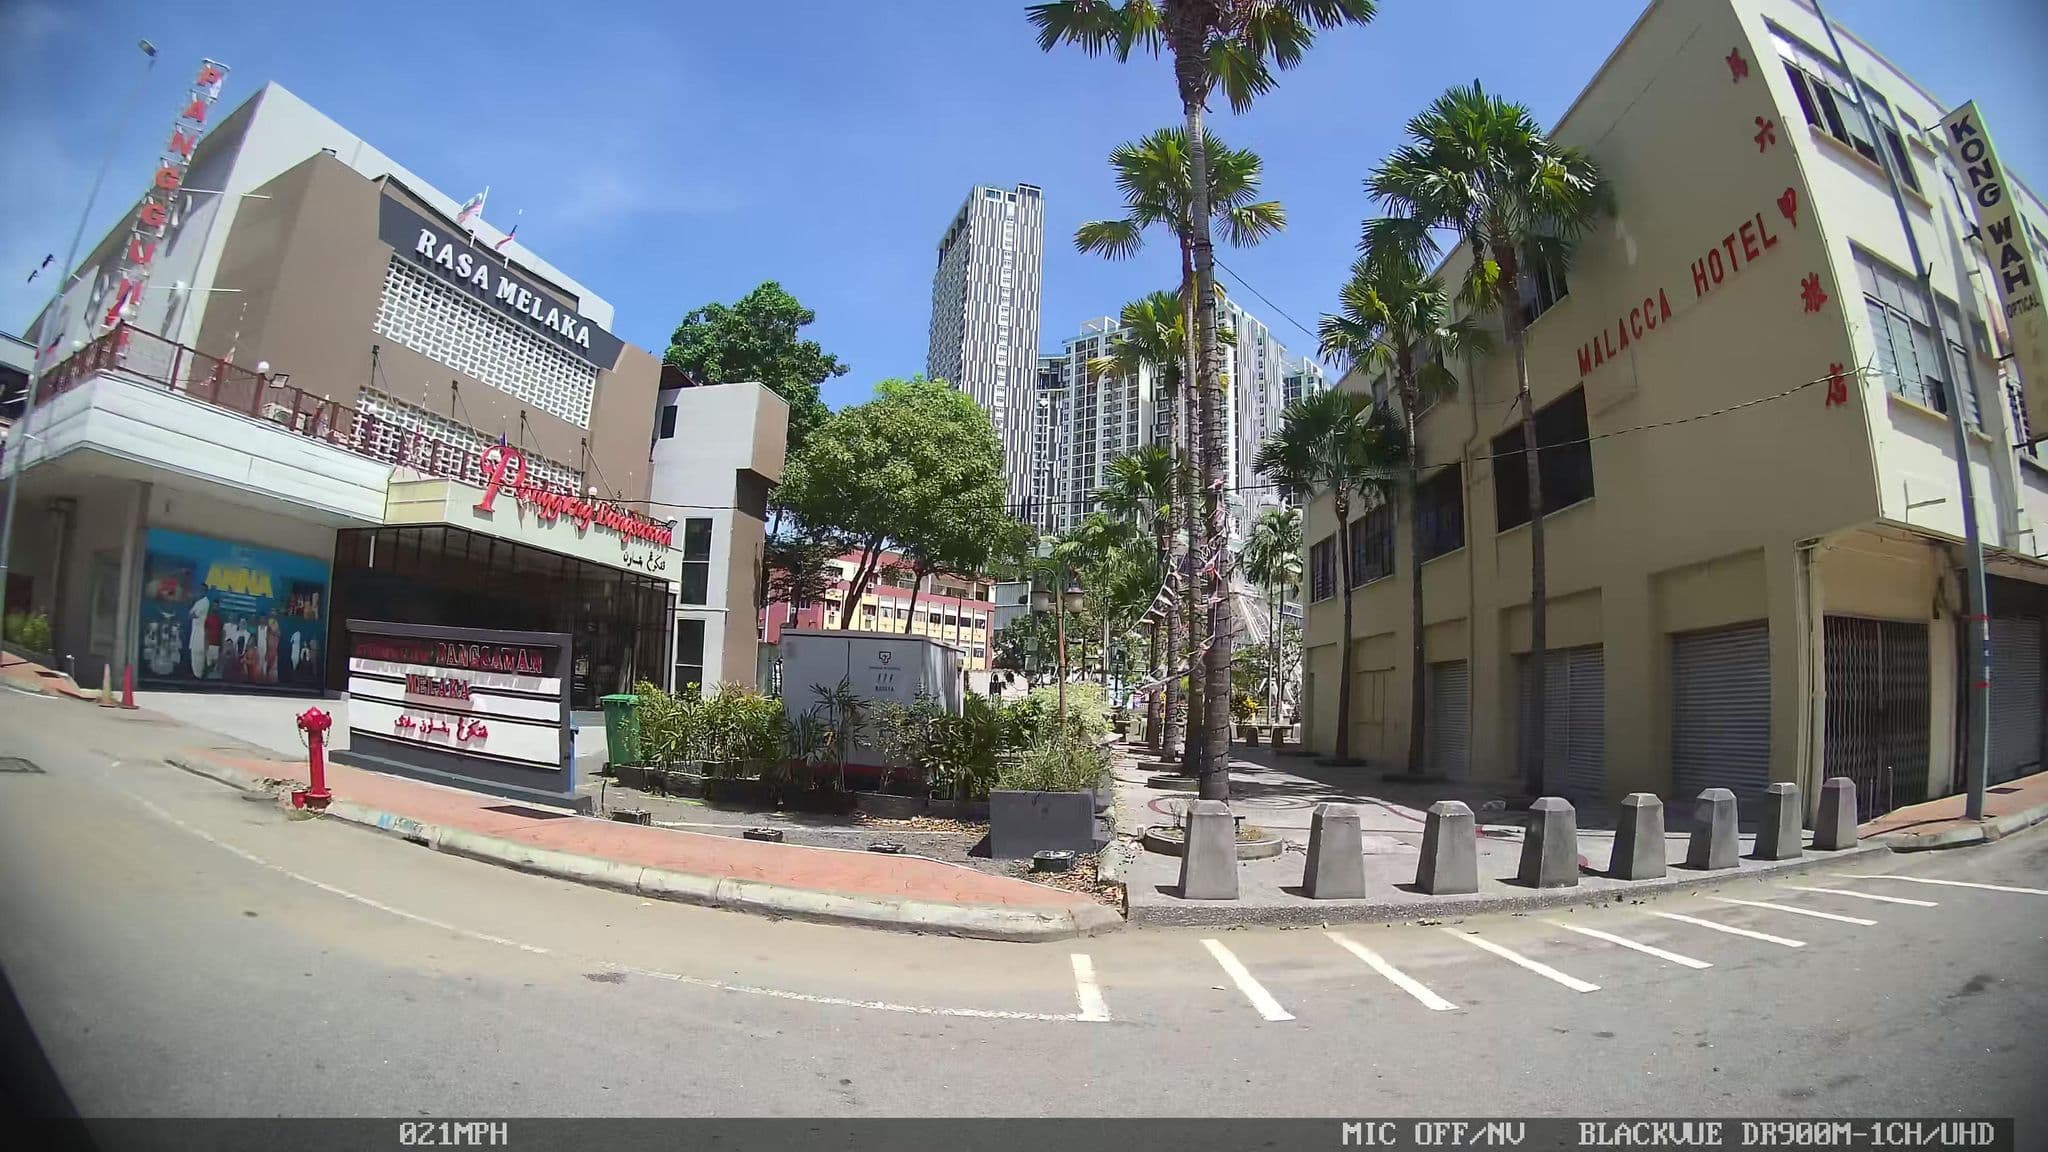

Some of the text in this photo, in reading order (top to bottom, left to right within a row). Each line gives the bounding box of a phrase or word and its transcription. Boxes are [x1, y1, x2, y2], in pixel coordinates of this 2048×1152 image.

[1950, 114, 2031, 294] KONG WAH
[415, 228, 591, 348] RASA MELAKA
[1577, 212, 1778, 377] MALACCA HOTEL
[405, 673, 471, 701] MELAKA
[435, 642, 544, 674] BANGSAWAN
